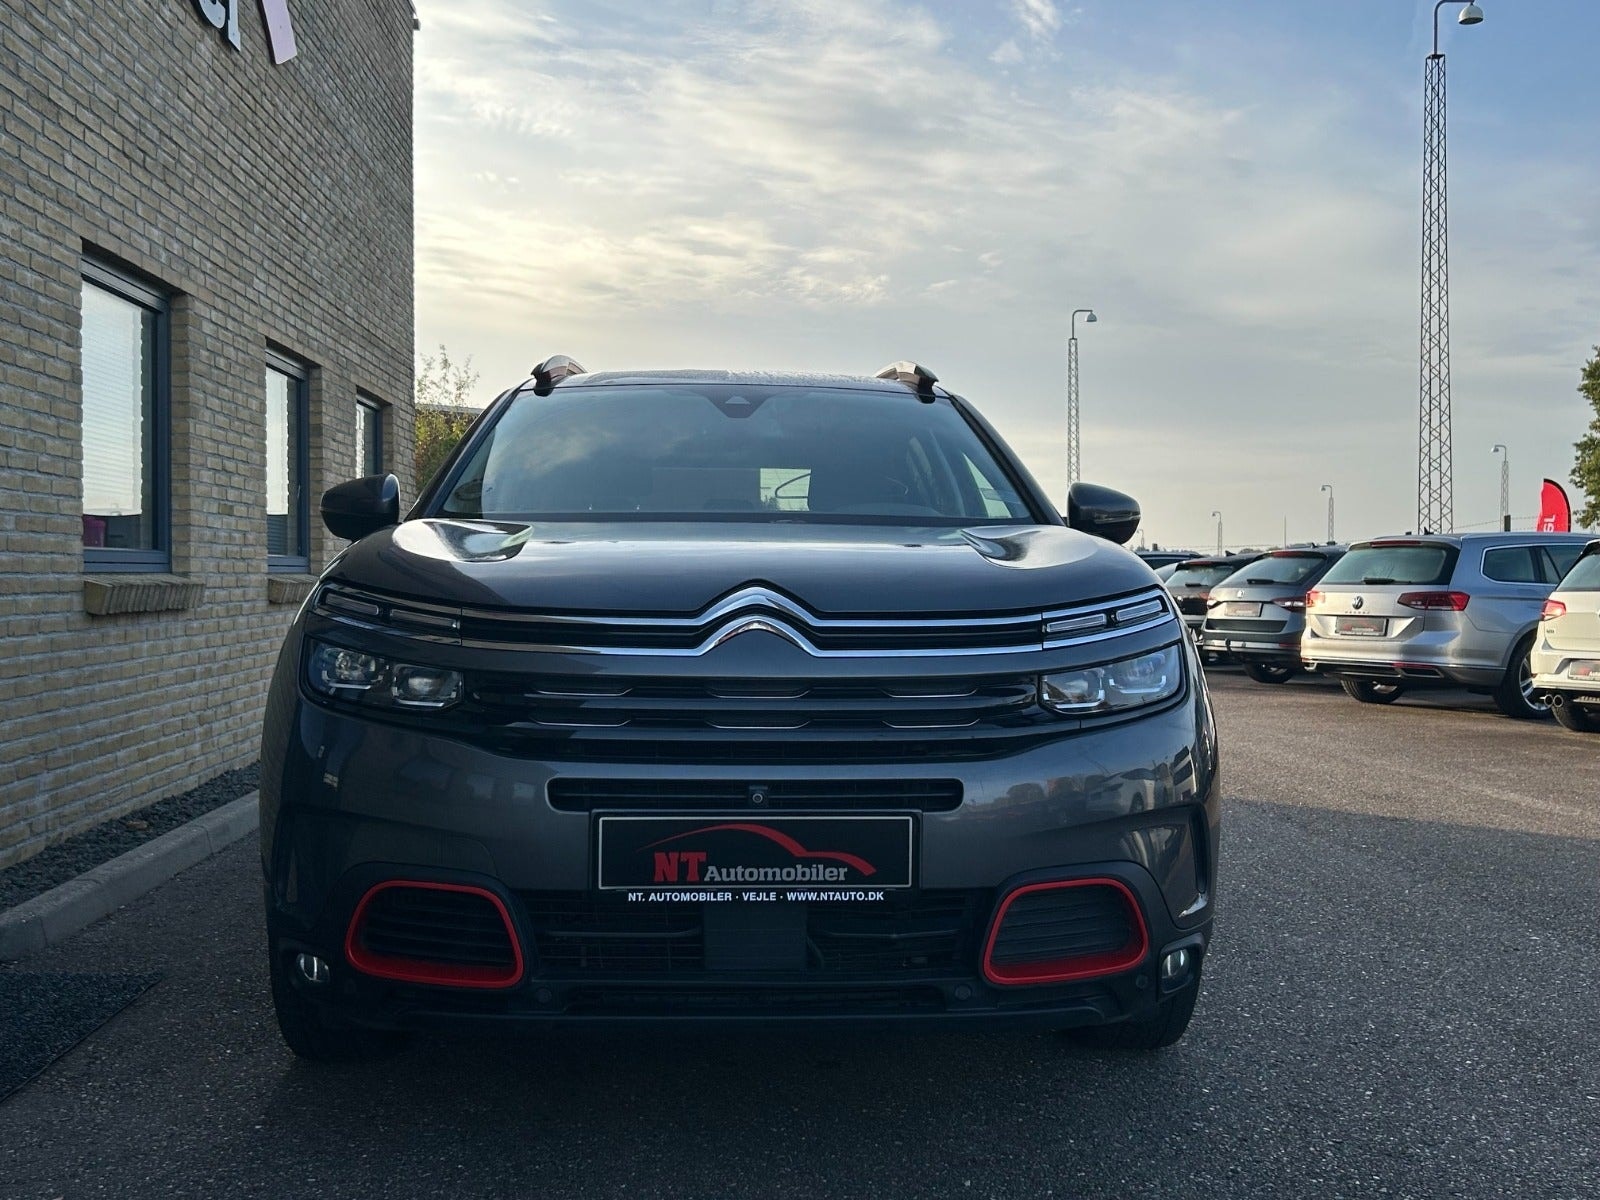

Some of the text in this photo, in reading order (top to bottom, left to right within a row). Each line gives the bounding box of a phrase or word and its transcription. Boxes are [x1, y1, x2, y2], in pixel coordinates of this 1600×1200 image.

[653, 851, 848, 882] NT Automobiler
[628, 891, 884, 902] NT. AUTOMOBILER VEJLE WWW.NTAUTO.DK
